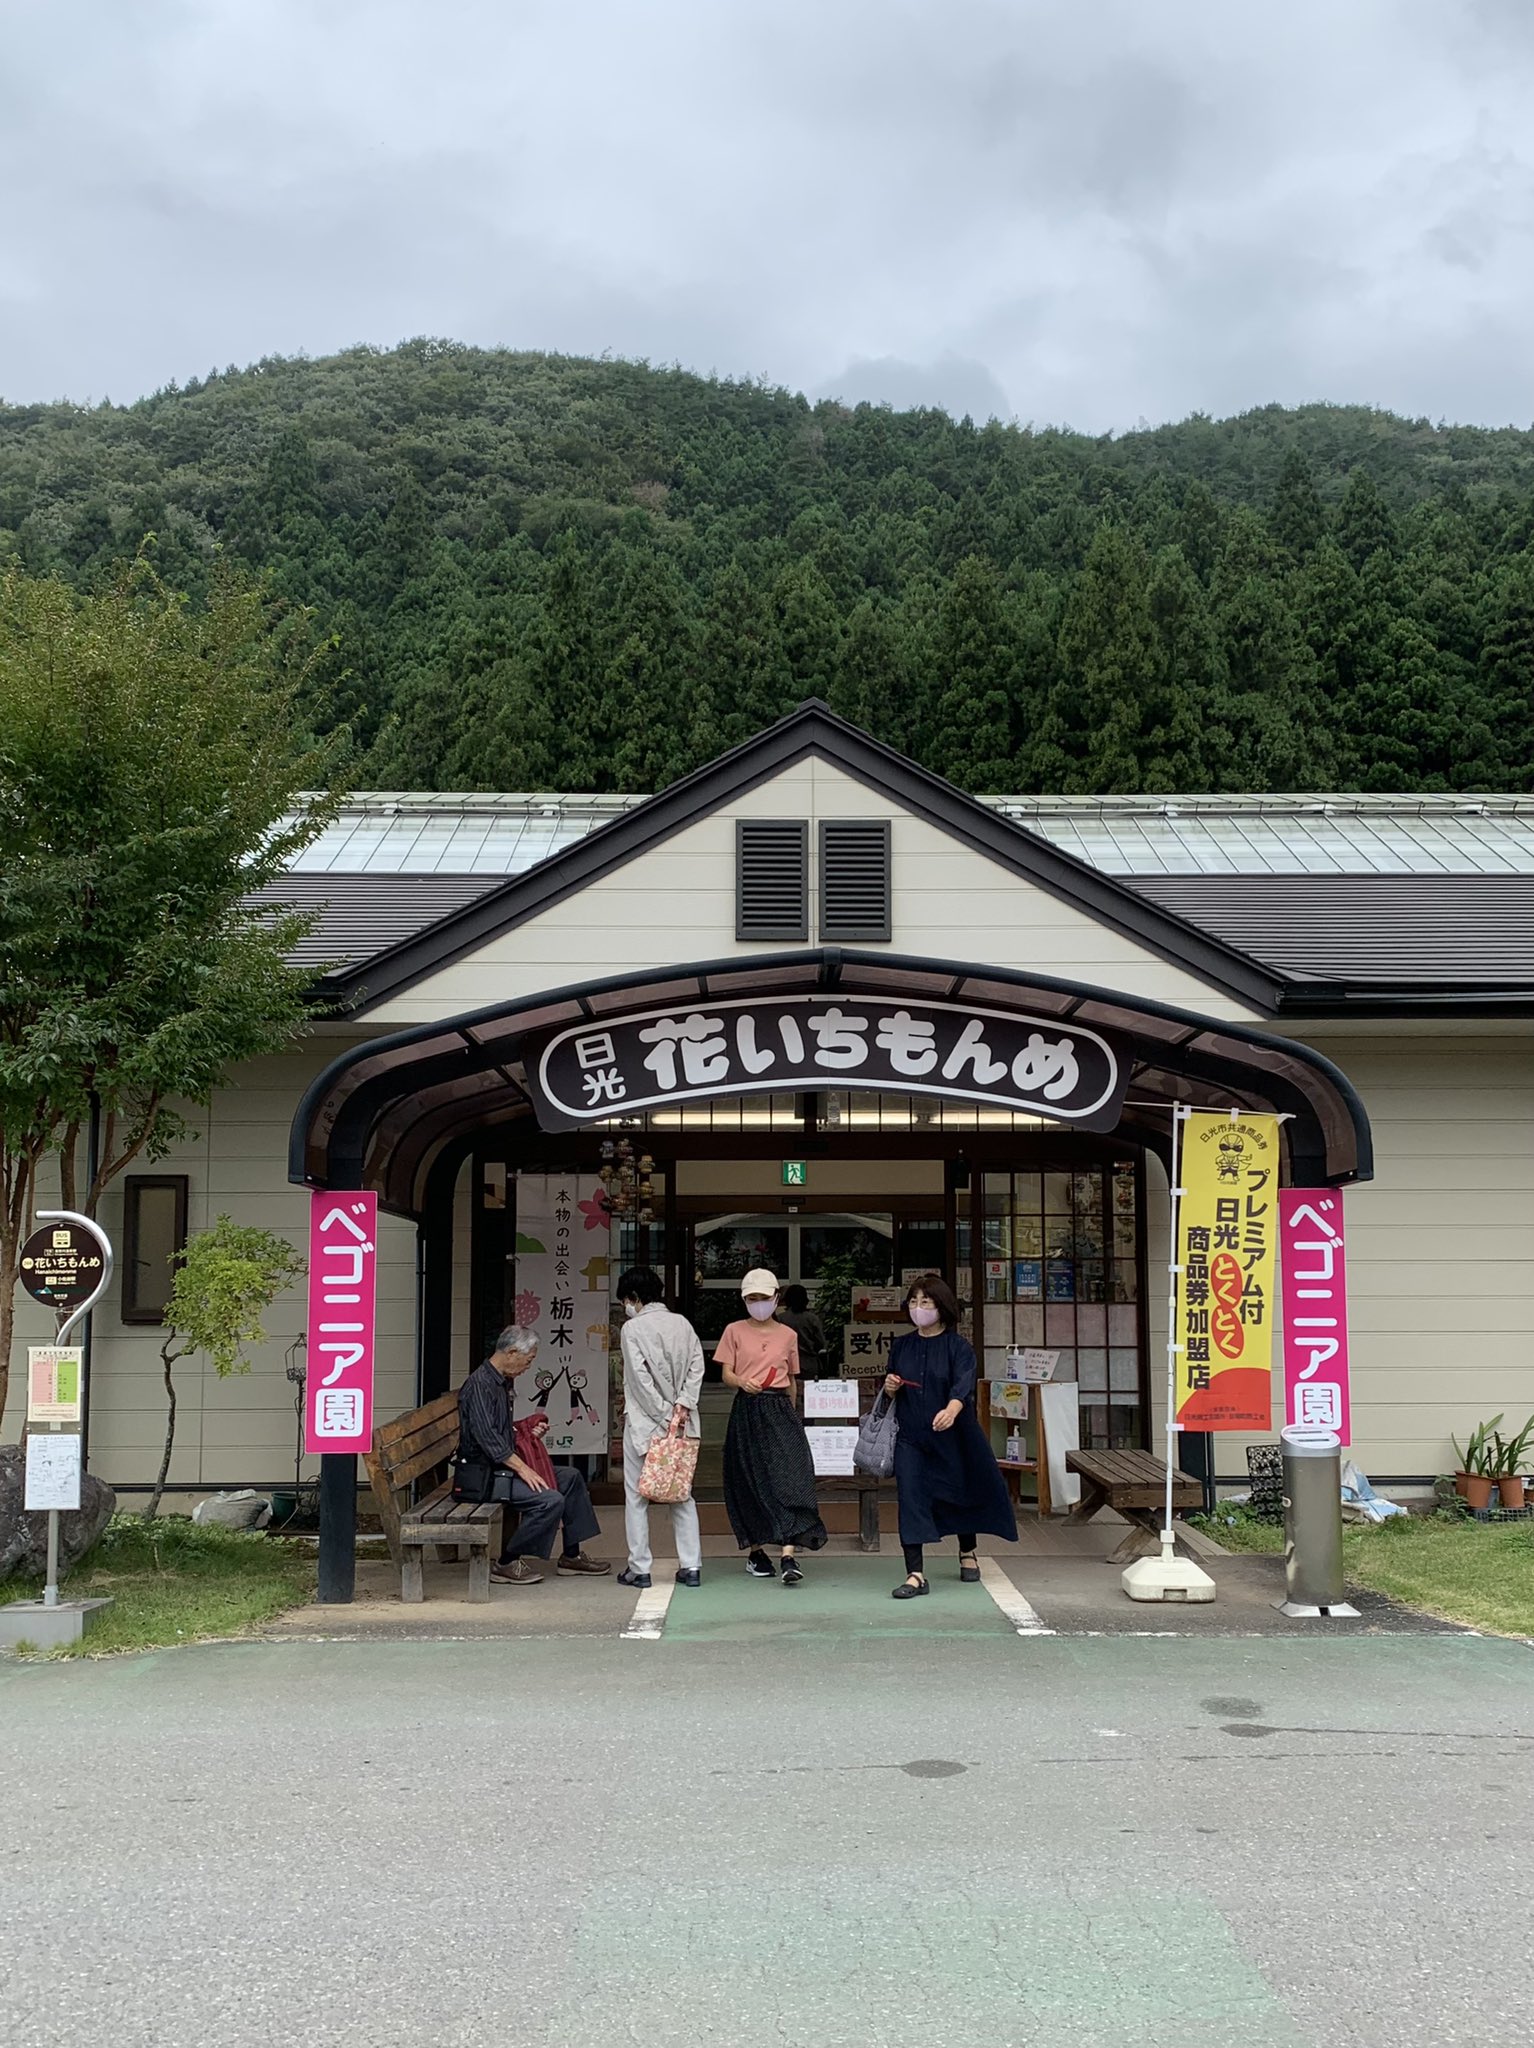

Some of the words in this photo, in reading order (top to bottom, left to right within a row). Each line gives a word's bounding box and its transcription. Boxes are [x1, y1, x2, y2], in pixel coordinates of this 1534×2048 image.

[574, 1032, 626, 1107] 日光
[639, 1007, 1081, 1101] 花いちもんめ
[1199, 1123, 1269, 1151] 日光市共通商品券
[34, 1257, 99, 1268] 花いちもんめ
[554, 1188, 571, 1290] 本物の出会い
[1238, 1169, 1271, 1325] プレミアム付
[315, 1202, 374, 1438] ベゴニア園
[549, 1296, 574, 1348] 栃木
[1186, 1226, 1210, 1390] 商品券加盟店
[1288, 1198, 1344, 1433] ベゴニア園
[842, 1363, 888, 1375] Recepti
[556, 1436, 574, 1446] JR
